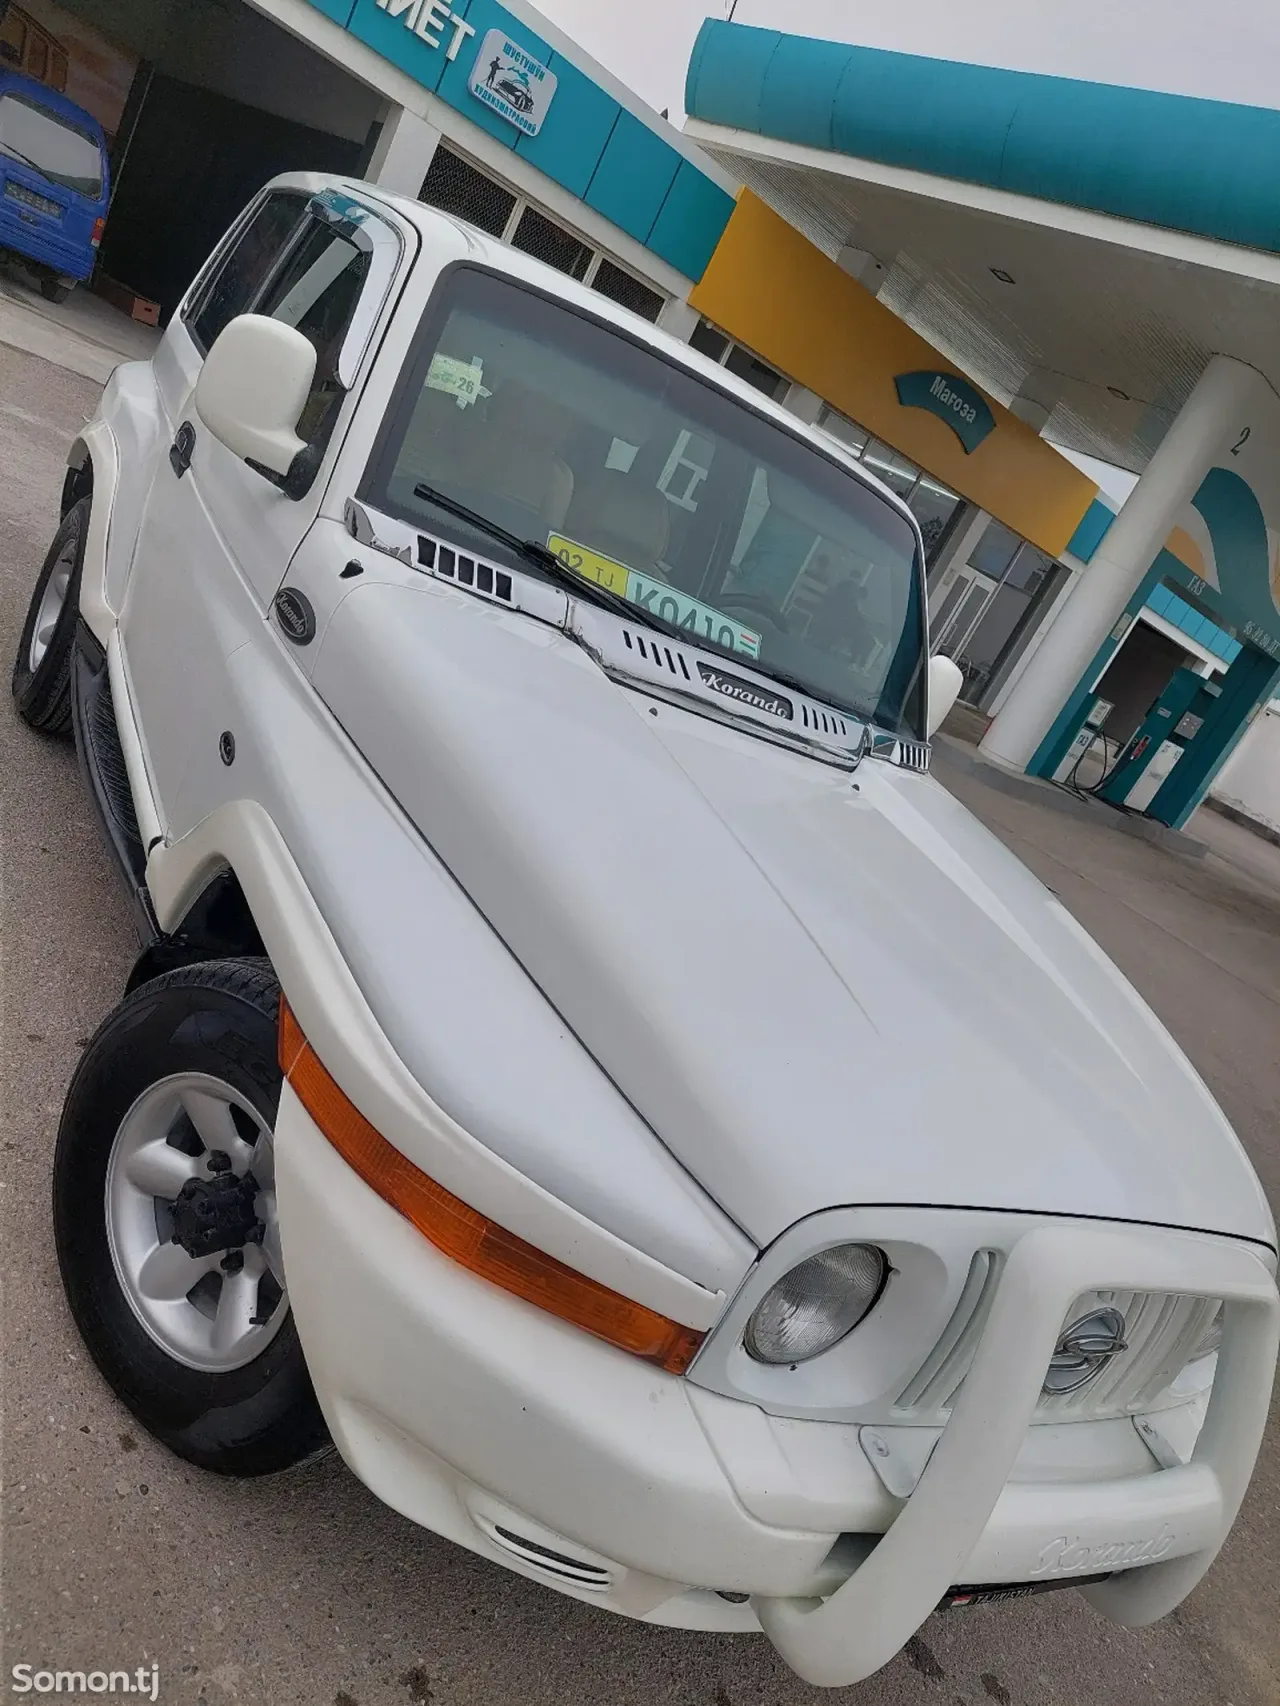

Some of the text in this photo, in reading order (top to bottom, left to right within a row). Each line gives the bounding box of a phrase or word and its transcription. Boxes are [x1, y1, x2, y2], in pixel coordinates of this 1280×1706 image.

[457, 377, 475, 394] 26
[1230, 426, 1251, 456] 2
[595, 566, 614, 588] TJ
[276, 592, 304, 633] Korando
[702, 672, 788, 718] Korando
